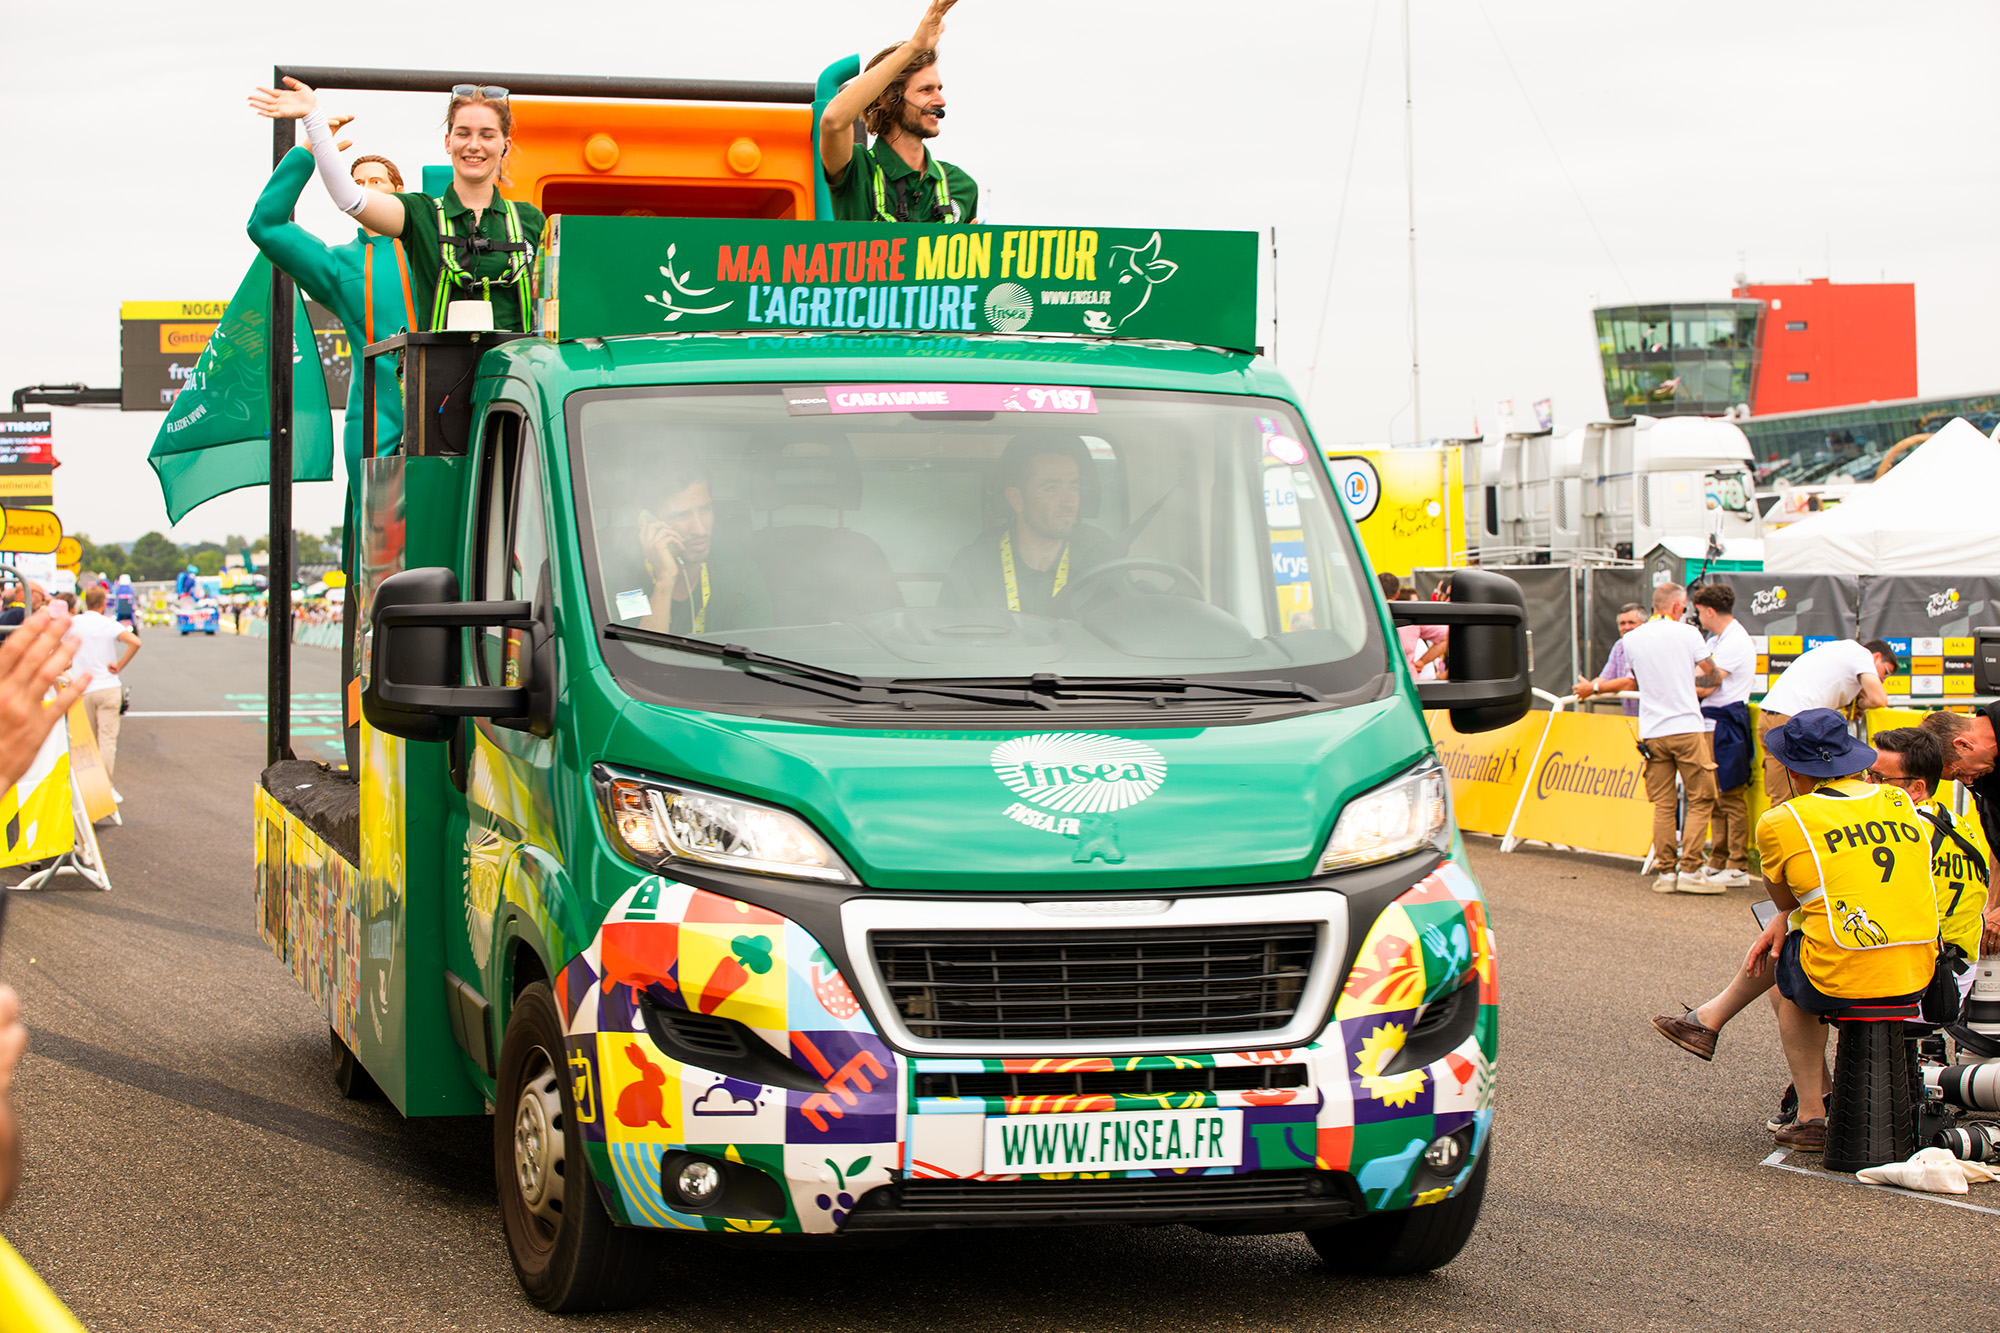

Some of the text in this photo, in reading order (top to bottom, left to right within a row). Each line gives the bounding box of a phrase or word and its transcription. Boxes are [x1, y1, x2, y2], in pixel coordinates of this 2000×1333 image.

[717, 230, 1099, 283] MA NATURE MON FUTUR
[748, 285, 979, 330] L'AGRICULTURE
[1041, 290, 1112, 305] WWW.FNSEA.FR
[836, 391, 949, 407] CARAVANE
[1027, 388, 1090, 410] 9187
[1020, 760, 1147, 788] fnsea
[1537, 751, 1644, 800] Continental
[1002, 802, 1081, 836] FNSEA.FR
[1824, 821, 1920, 854] PHOTO
[1872, 846, 1895, 883] 9
[1945, 881, 1965, 917] 7
[1002, 1117, 1223, 1166] WWW.FNSEA.FR
